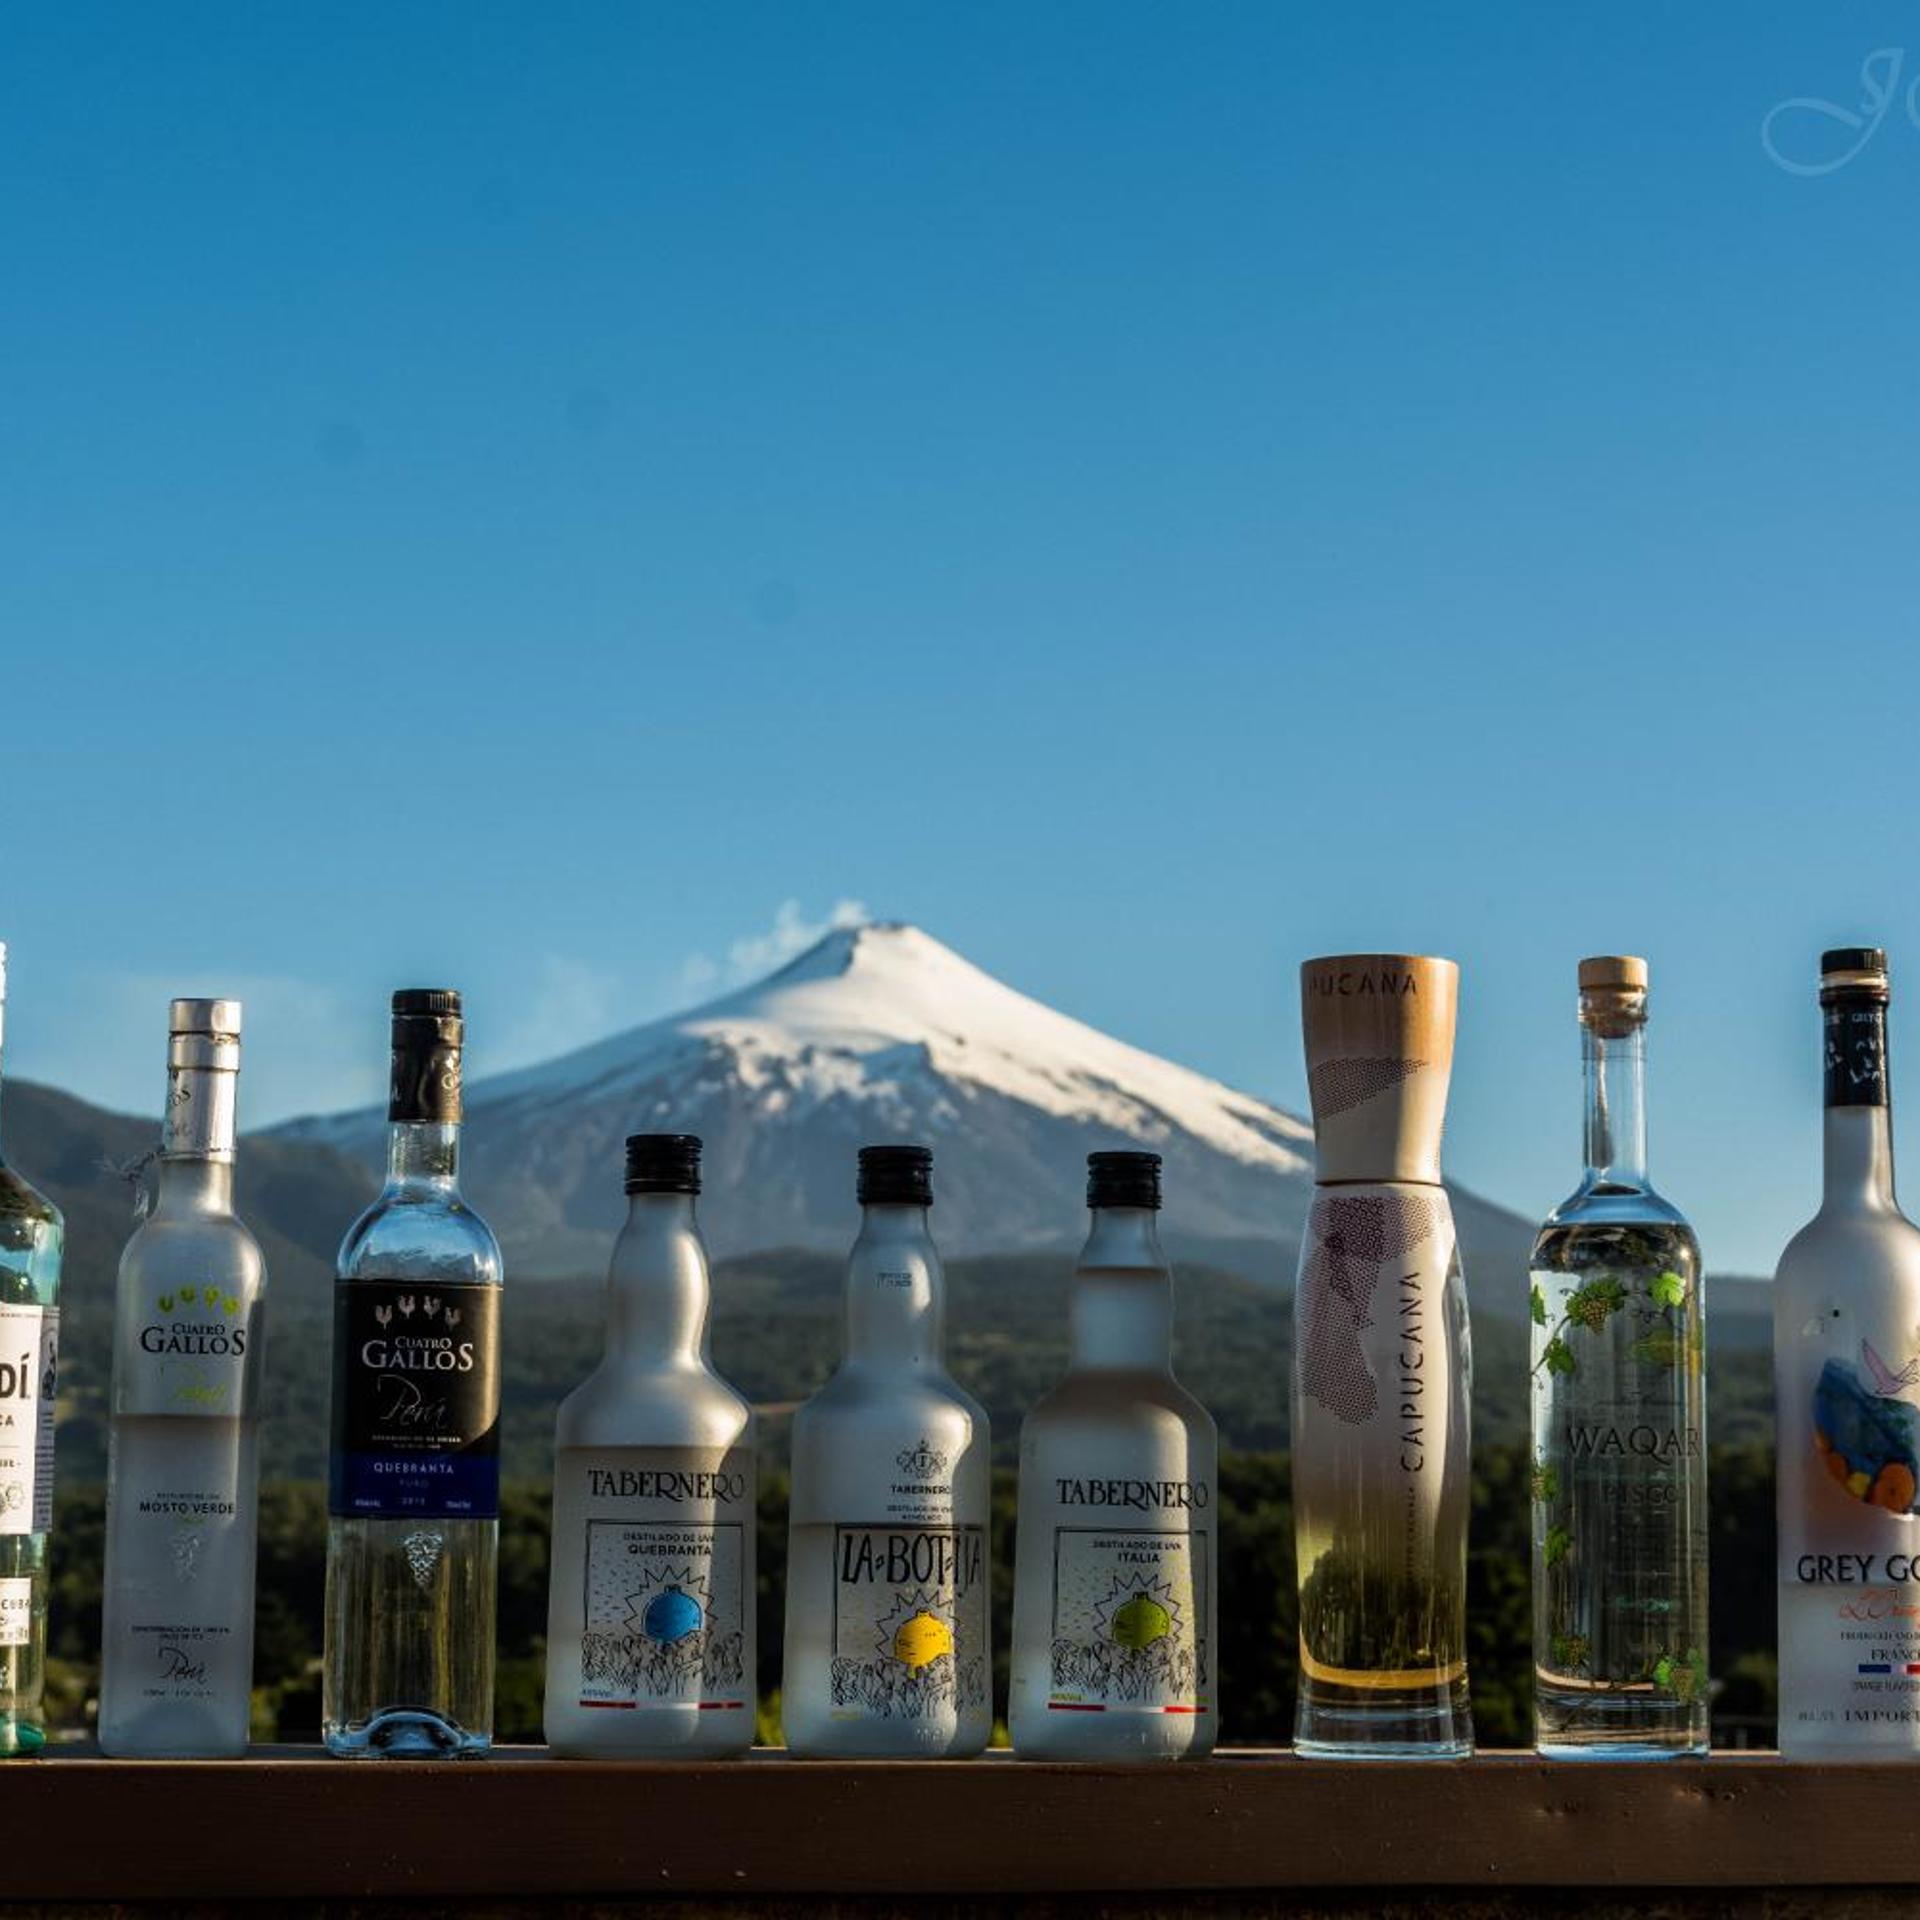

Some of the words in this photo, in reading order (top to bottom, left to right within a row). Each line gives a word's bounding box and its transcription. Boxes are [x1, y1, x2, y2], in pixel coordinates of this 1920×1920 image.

[172, 1322, 225, 1336] CUATRO
[141, 1326, 245, 1356] GALLOS
[395, 1336, 452, 1350] CUATRO
[362, 1340, 474, 1372] GALLOS
[1400, 1271, 1425, 1473] CAPUCANA
[1567, 1425, 1700, 1466] WAQAR
[373, 1462, 455, 1475] QUEBRANTA
[587, 1470, 745, 1504] TABERNERO
[891, 1484, 951, 1495] TABERNERO
[1056, 1479, 1209, 1512] TABERNERO
[139, 1502, 188, 1515] MOSTO
[193, 1502, 236, 1515] VERDE
[628, 1543, 712, 1556] QUEBRANTA
[1118, 1552, 1161, 1564] ITALIA
[1798, 1554, 1875, 1583] GREY
